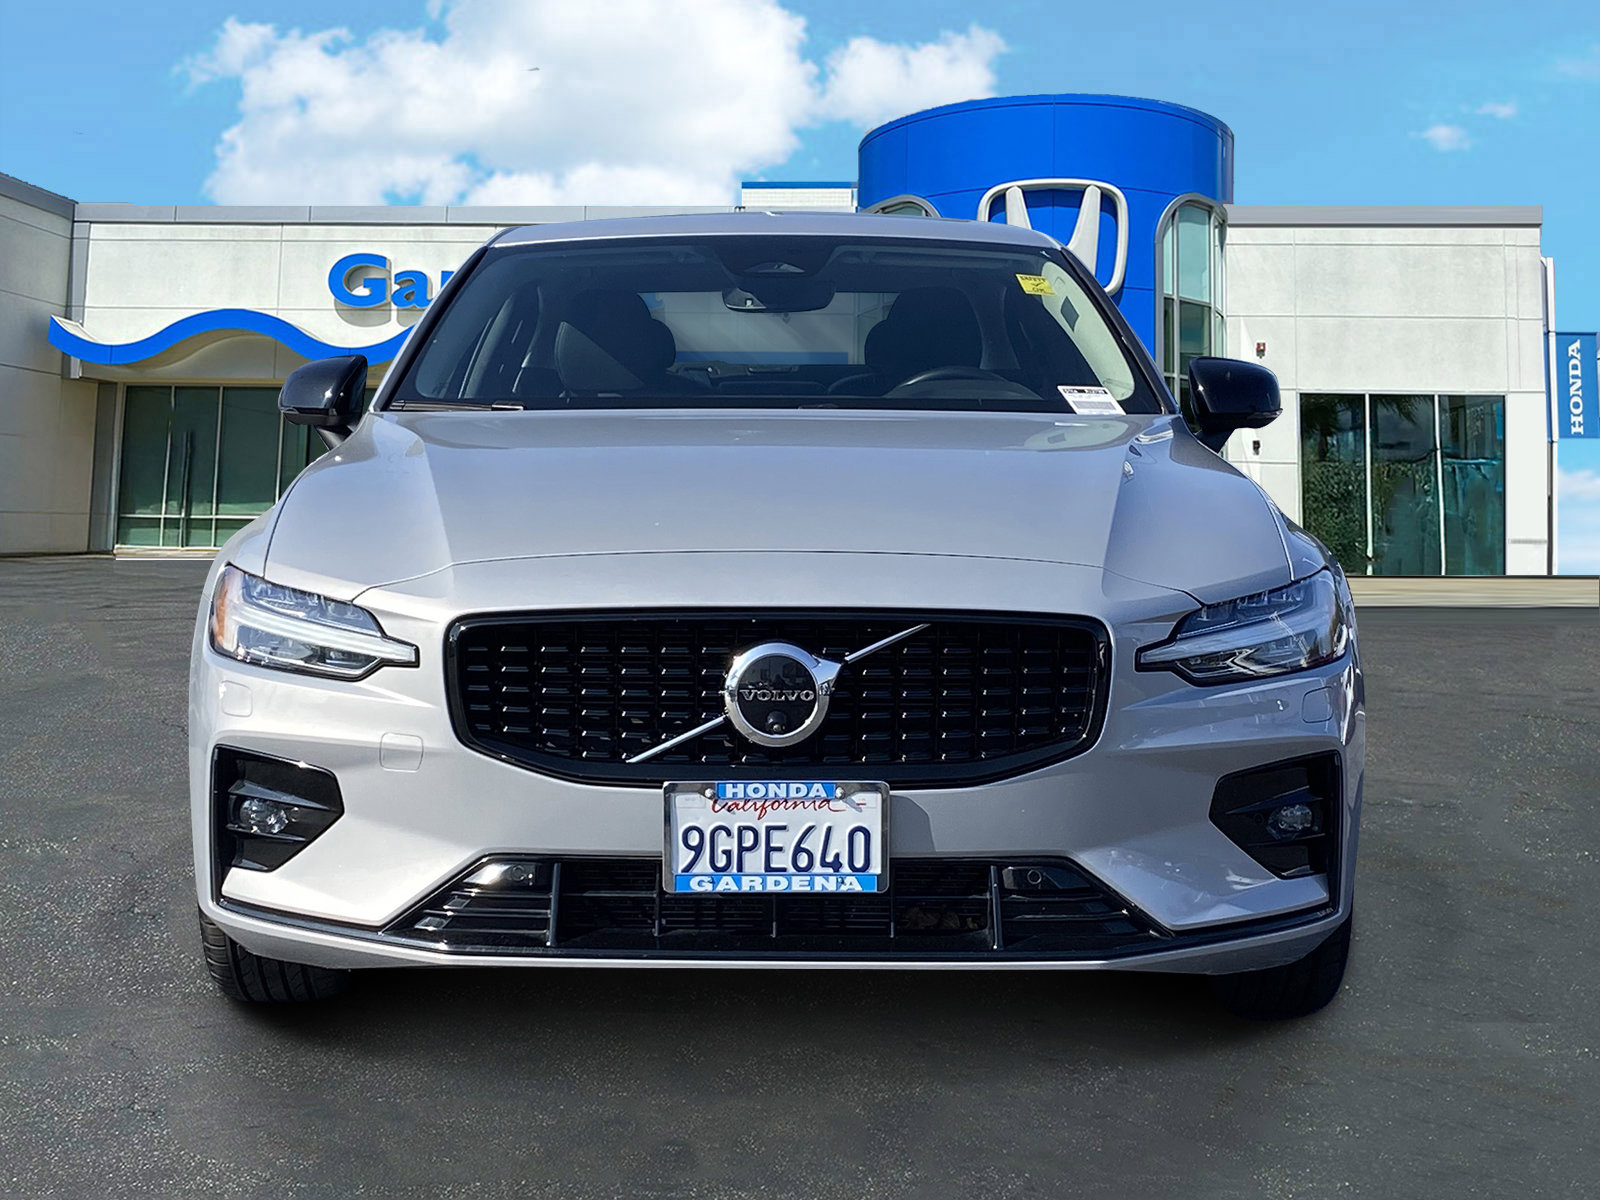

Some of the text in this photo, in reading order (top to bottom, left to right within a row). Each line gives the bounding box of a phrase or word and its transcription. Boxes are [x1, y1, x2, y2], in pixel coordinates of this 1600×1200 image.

[1568, 339, 1584, 435] HONDA
[739, 690, 815, 701] VOLVO
[725, 783, 827, 798] HONDA
[711, 798, 846, 820] California
[681, 825, 871, 873] 9GPE640
[689, 876, 862, 892] GARDENA
